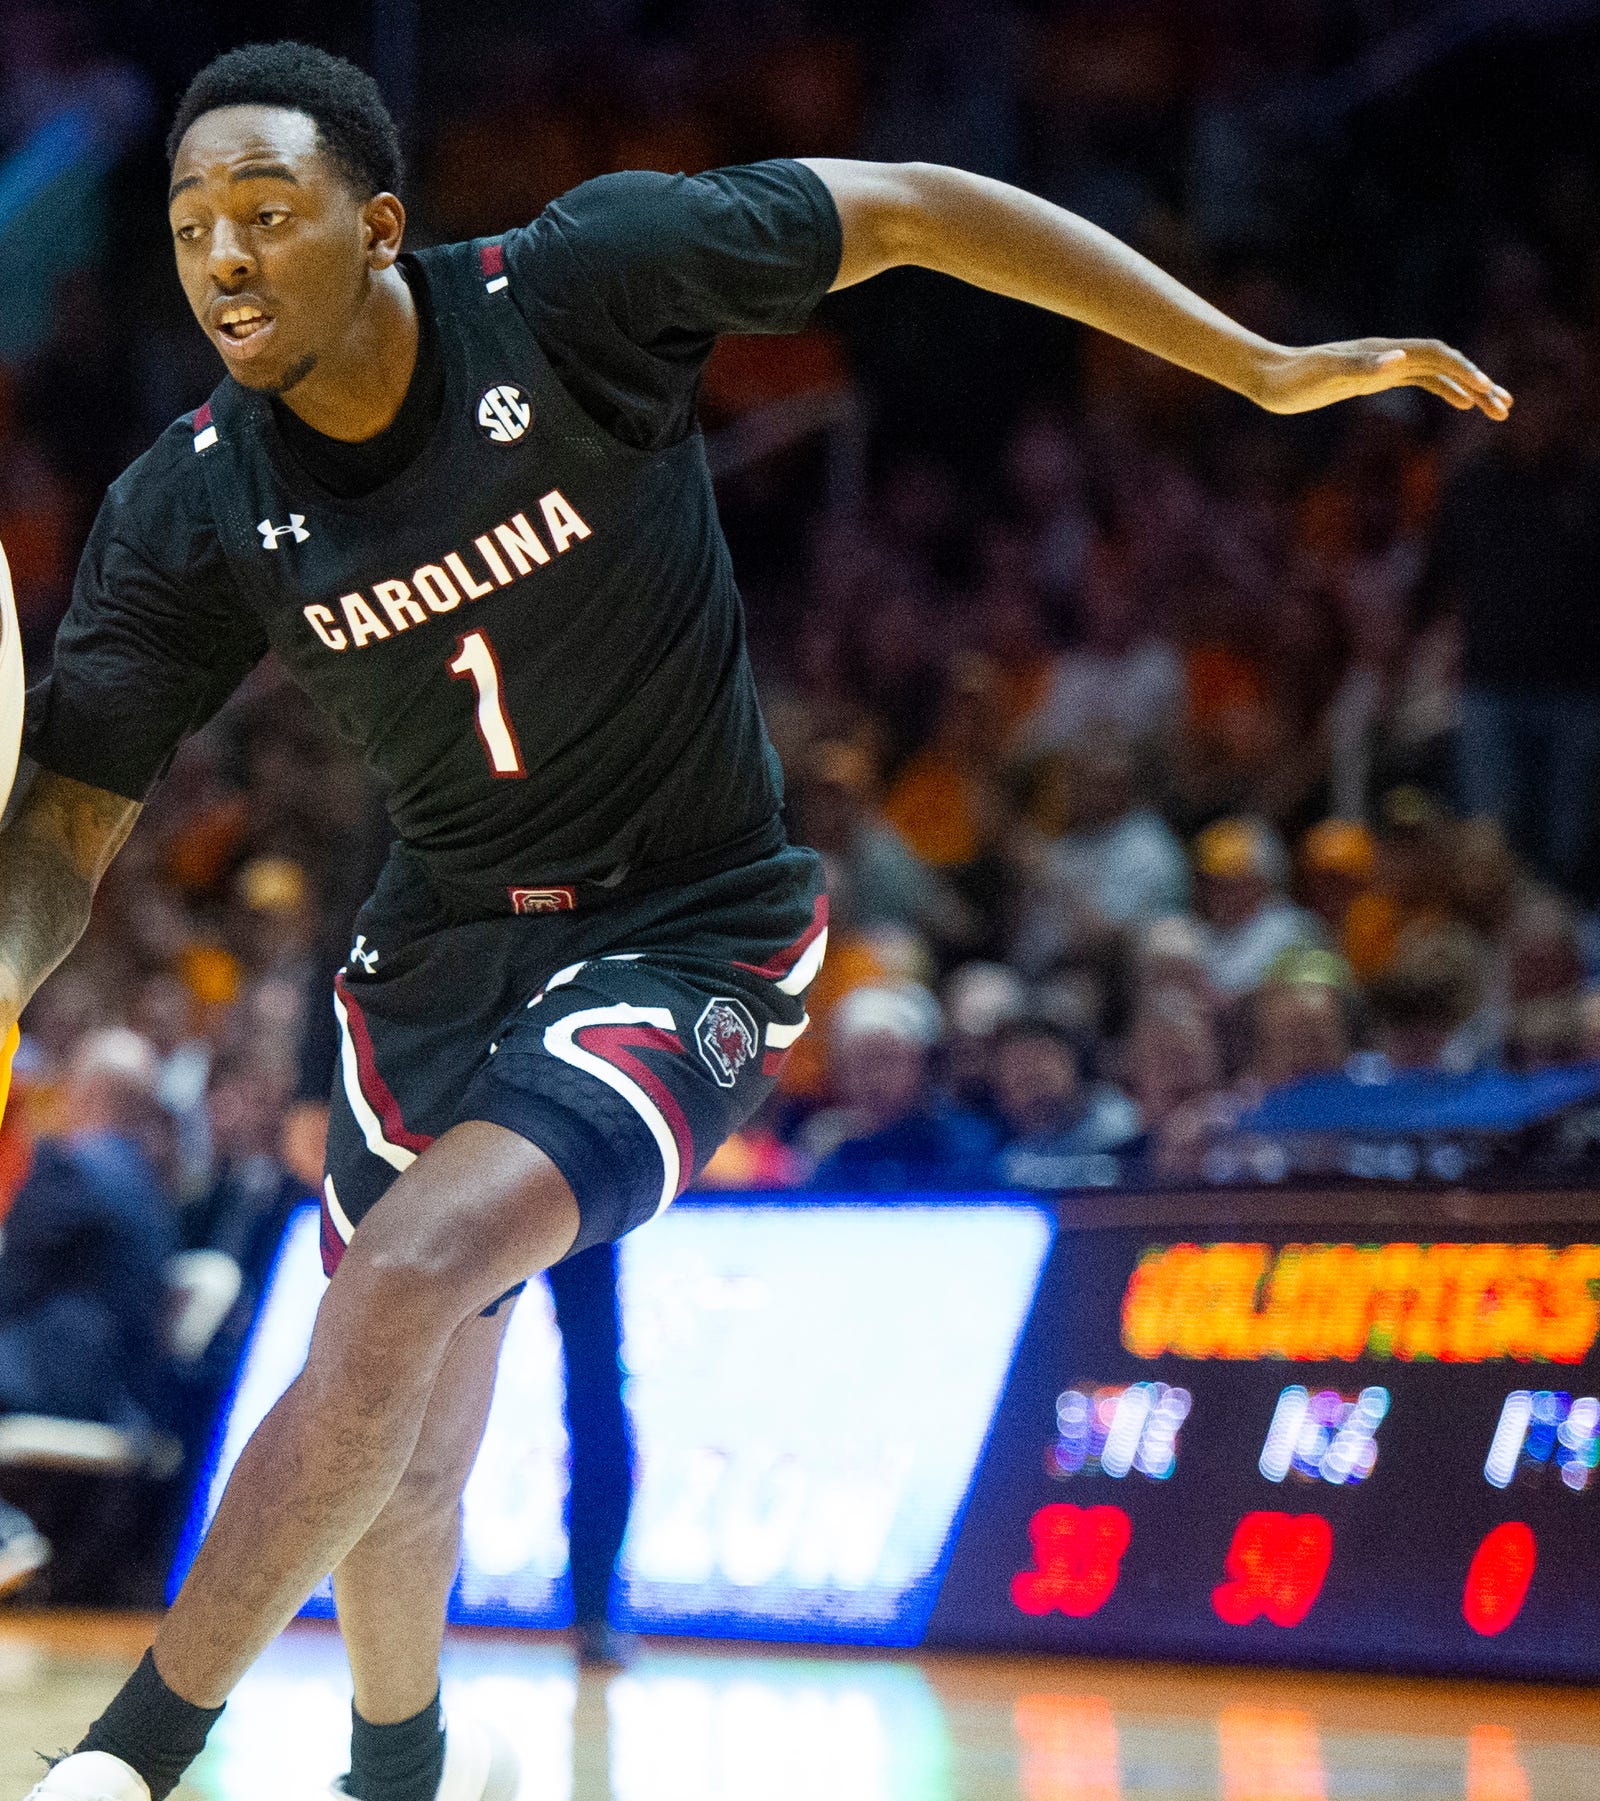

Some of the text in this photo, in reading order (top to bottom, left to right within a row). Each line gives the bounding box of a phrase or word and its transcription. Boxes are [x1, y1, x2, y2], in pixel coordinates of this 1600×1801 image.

[478, 385, 531, 442] SEC
[302, 488, 593, 652] CAROLINA
[446, 627, 527, 778] 1
